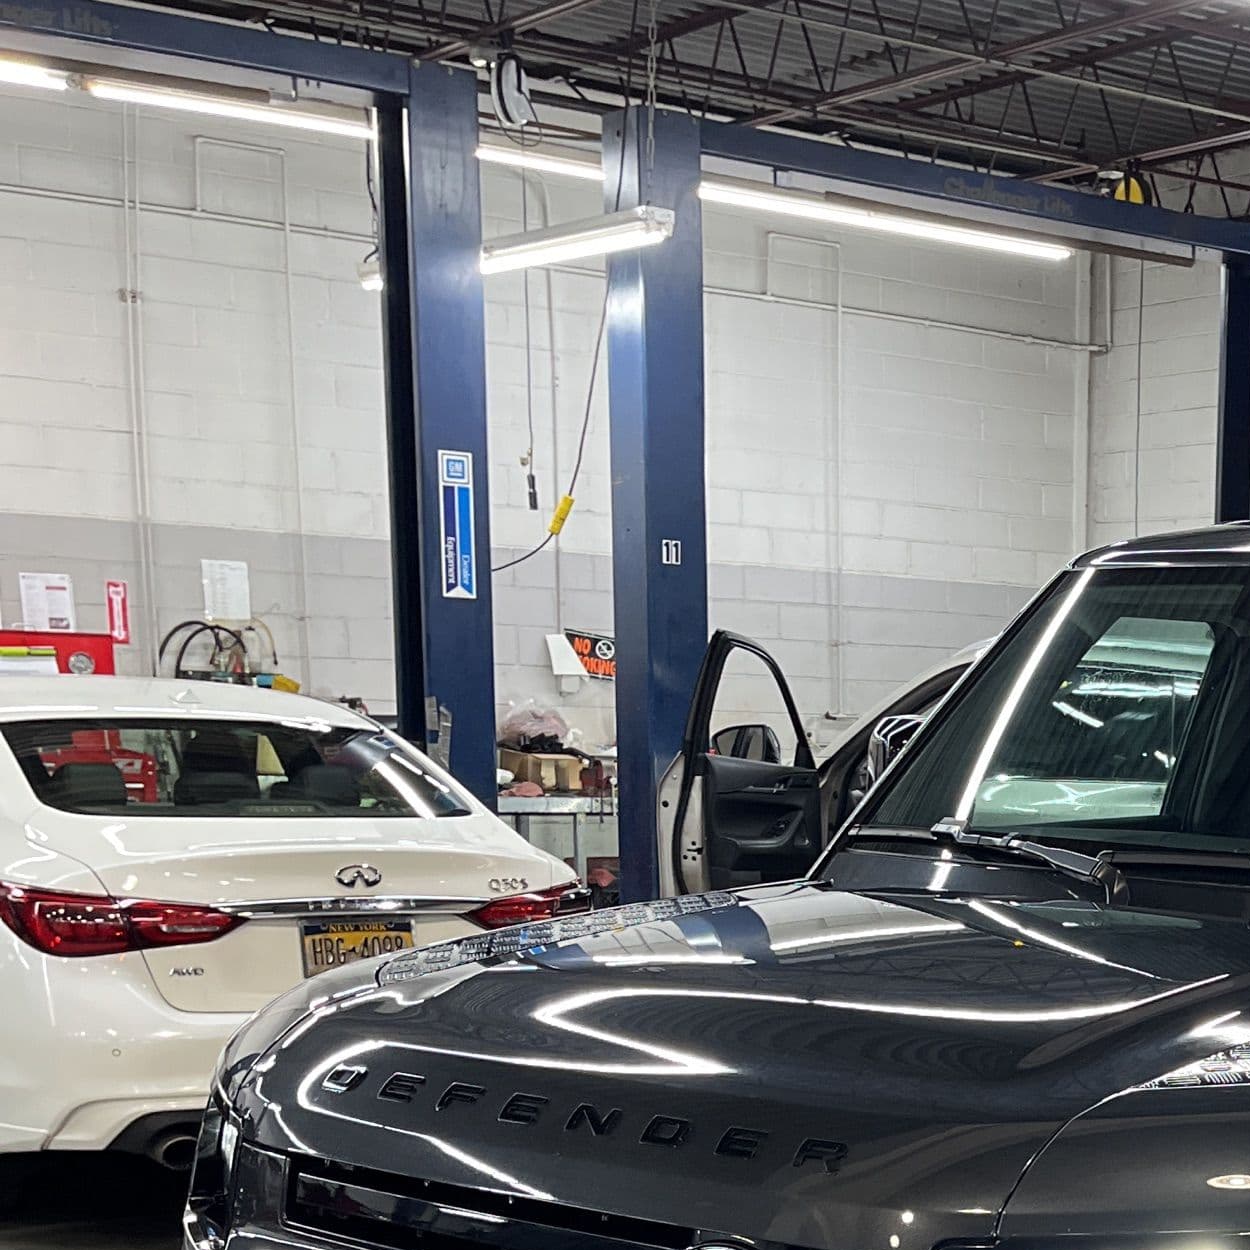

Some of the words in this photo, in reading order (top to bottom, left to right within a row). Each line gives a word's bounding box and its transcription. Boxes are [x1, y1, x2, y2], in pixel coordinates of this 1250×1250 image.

[448, 460, 463, 473] GM
[446, 535, 456, 585] Equipment
[663, 540, 680, 563] 11
[461, 554, 471, 586] Dealer
[574, 637, 592, 655] NO
[580, 656, 616, 677] OKING
[329, 922, 357, 933] NEW
[359, 921, 388, 932] YORK
[312, 937, 347, 966] HBG
[320, 1063, 849, 1176] DEFENDER
